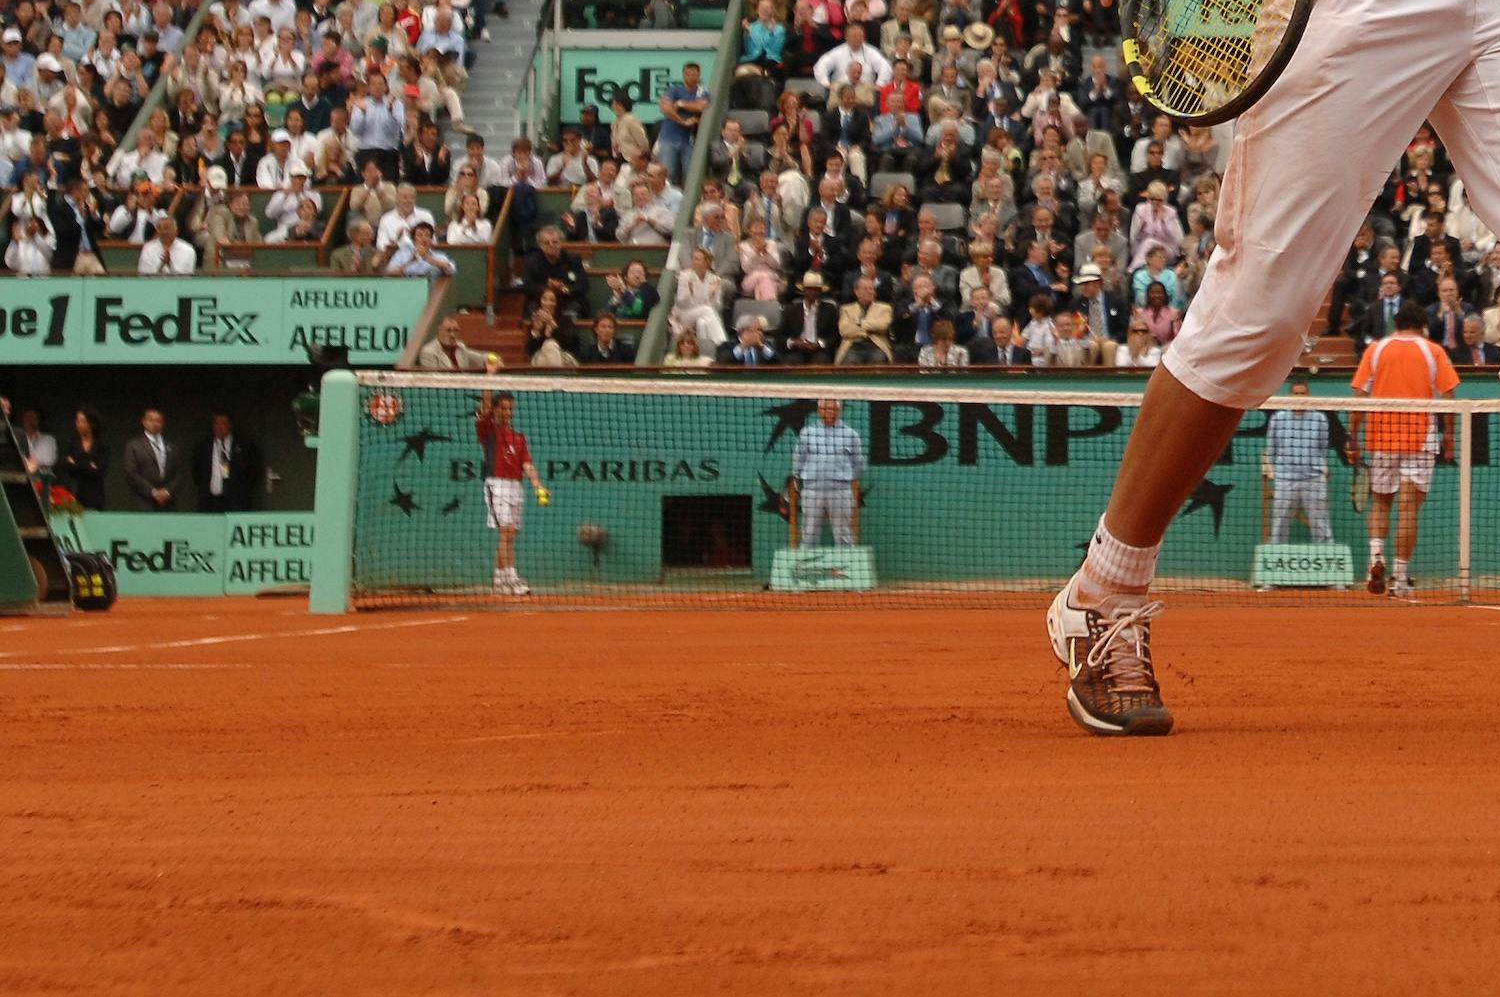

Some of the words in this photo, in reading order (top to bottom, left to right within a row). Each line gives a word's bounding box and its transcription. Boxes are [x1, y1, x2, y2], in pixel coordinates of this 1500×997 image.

[575, 67, 684, 106] FedE
[289, 290, 378, 309] AFFLELOU
[94, 296, 261, 346] FedEx
[869, 401, 1123, 467] BNP
[547, 459, 721, 482] PARIBAS
[230, 524, 314, 548] AFFLEL
[110, 539, 216, 574] FedEx
[1262, 557, 1345, 571] LACOSTE
[229, 560, 313, 583] AFFLEL
